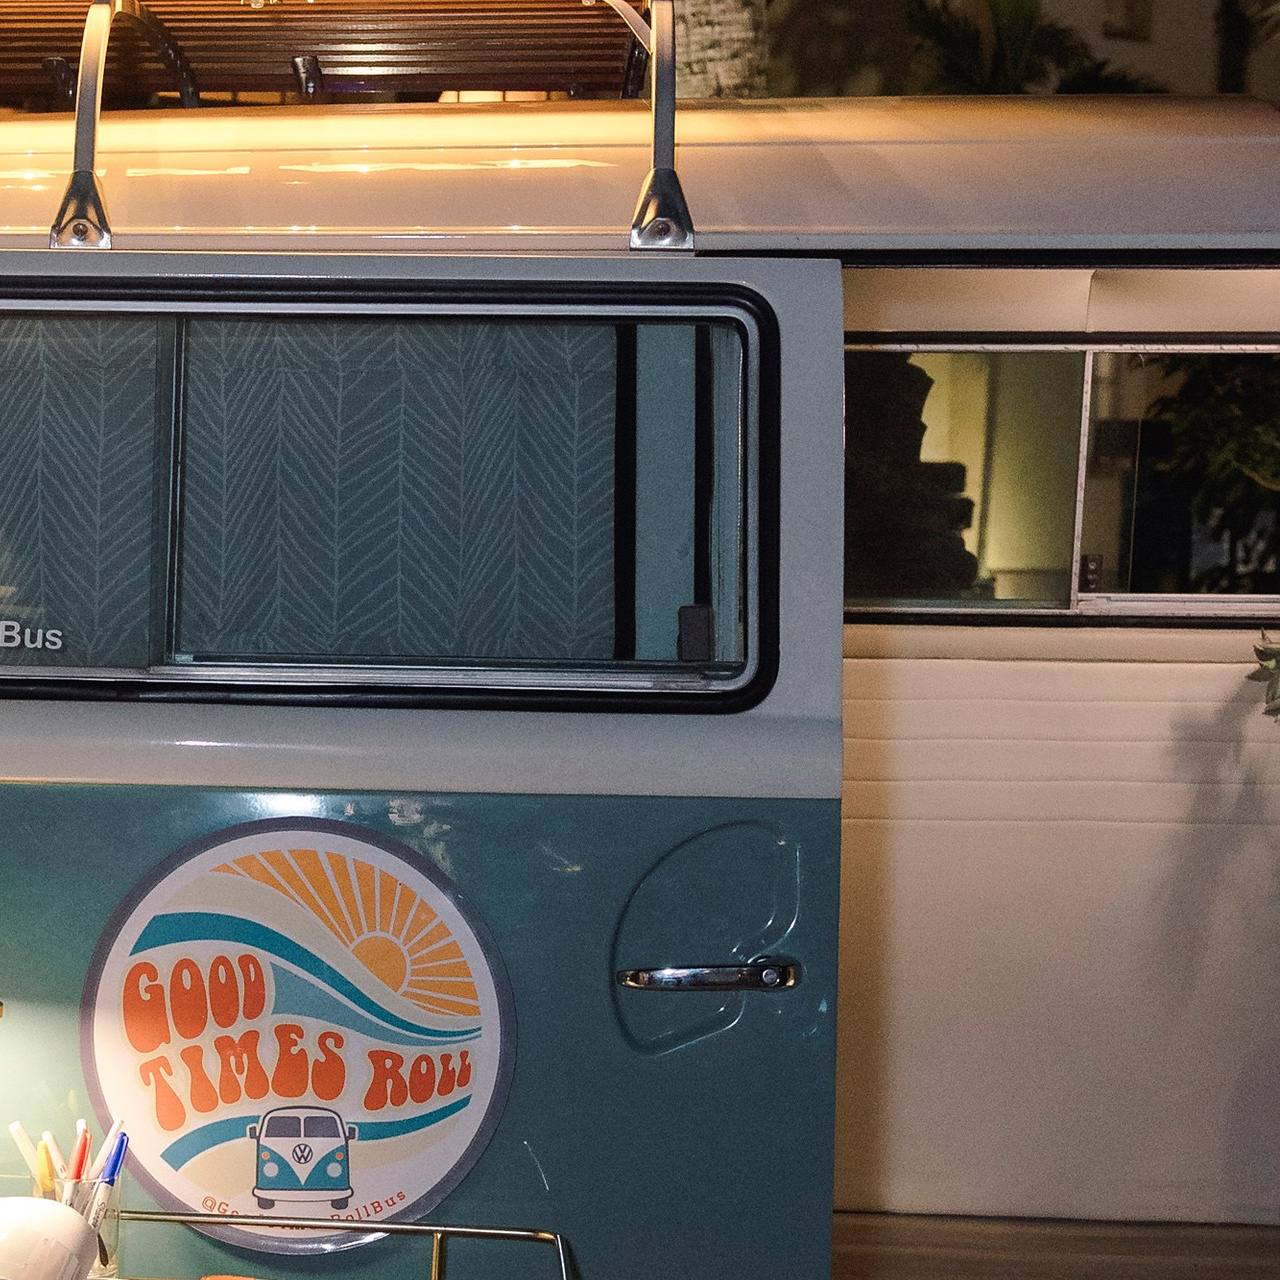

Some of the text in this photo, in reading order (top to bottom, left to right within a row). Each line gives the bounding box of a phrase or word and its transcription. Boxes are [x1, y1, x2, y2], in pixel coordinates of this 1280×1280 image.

[123, 953, 266, 1053] GOOD
[140, 1024, 472, 1131] TIMES ROLL
